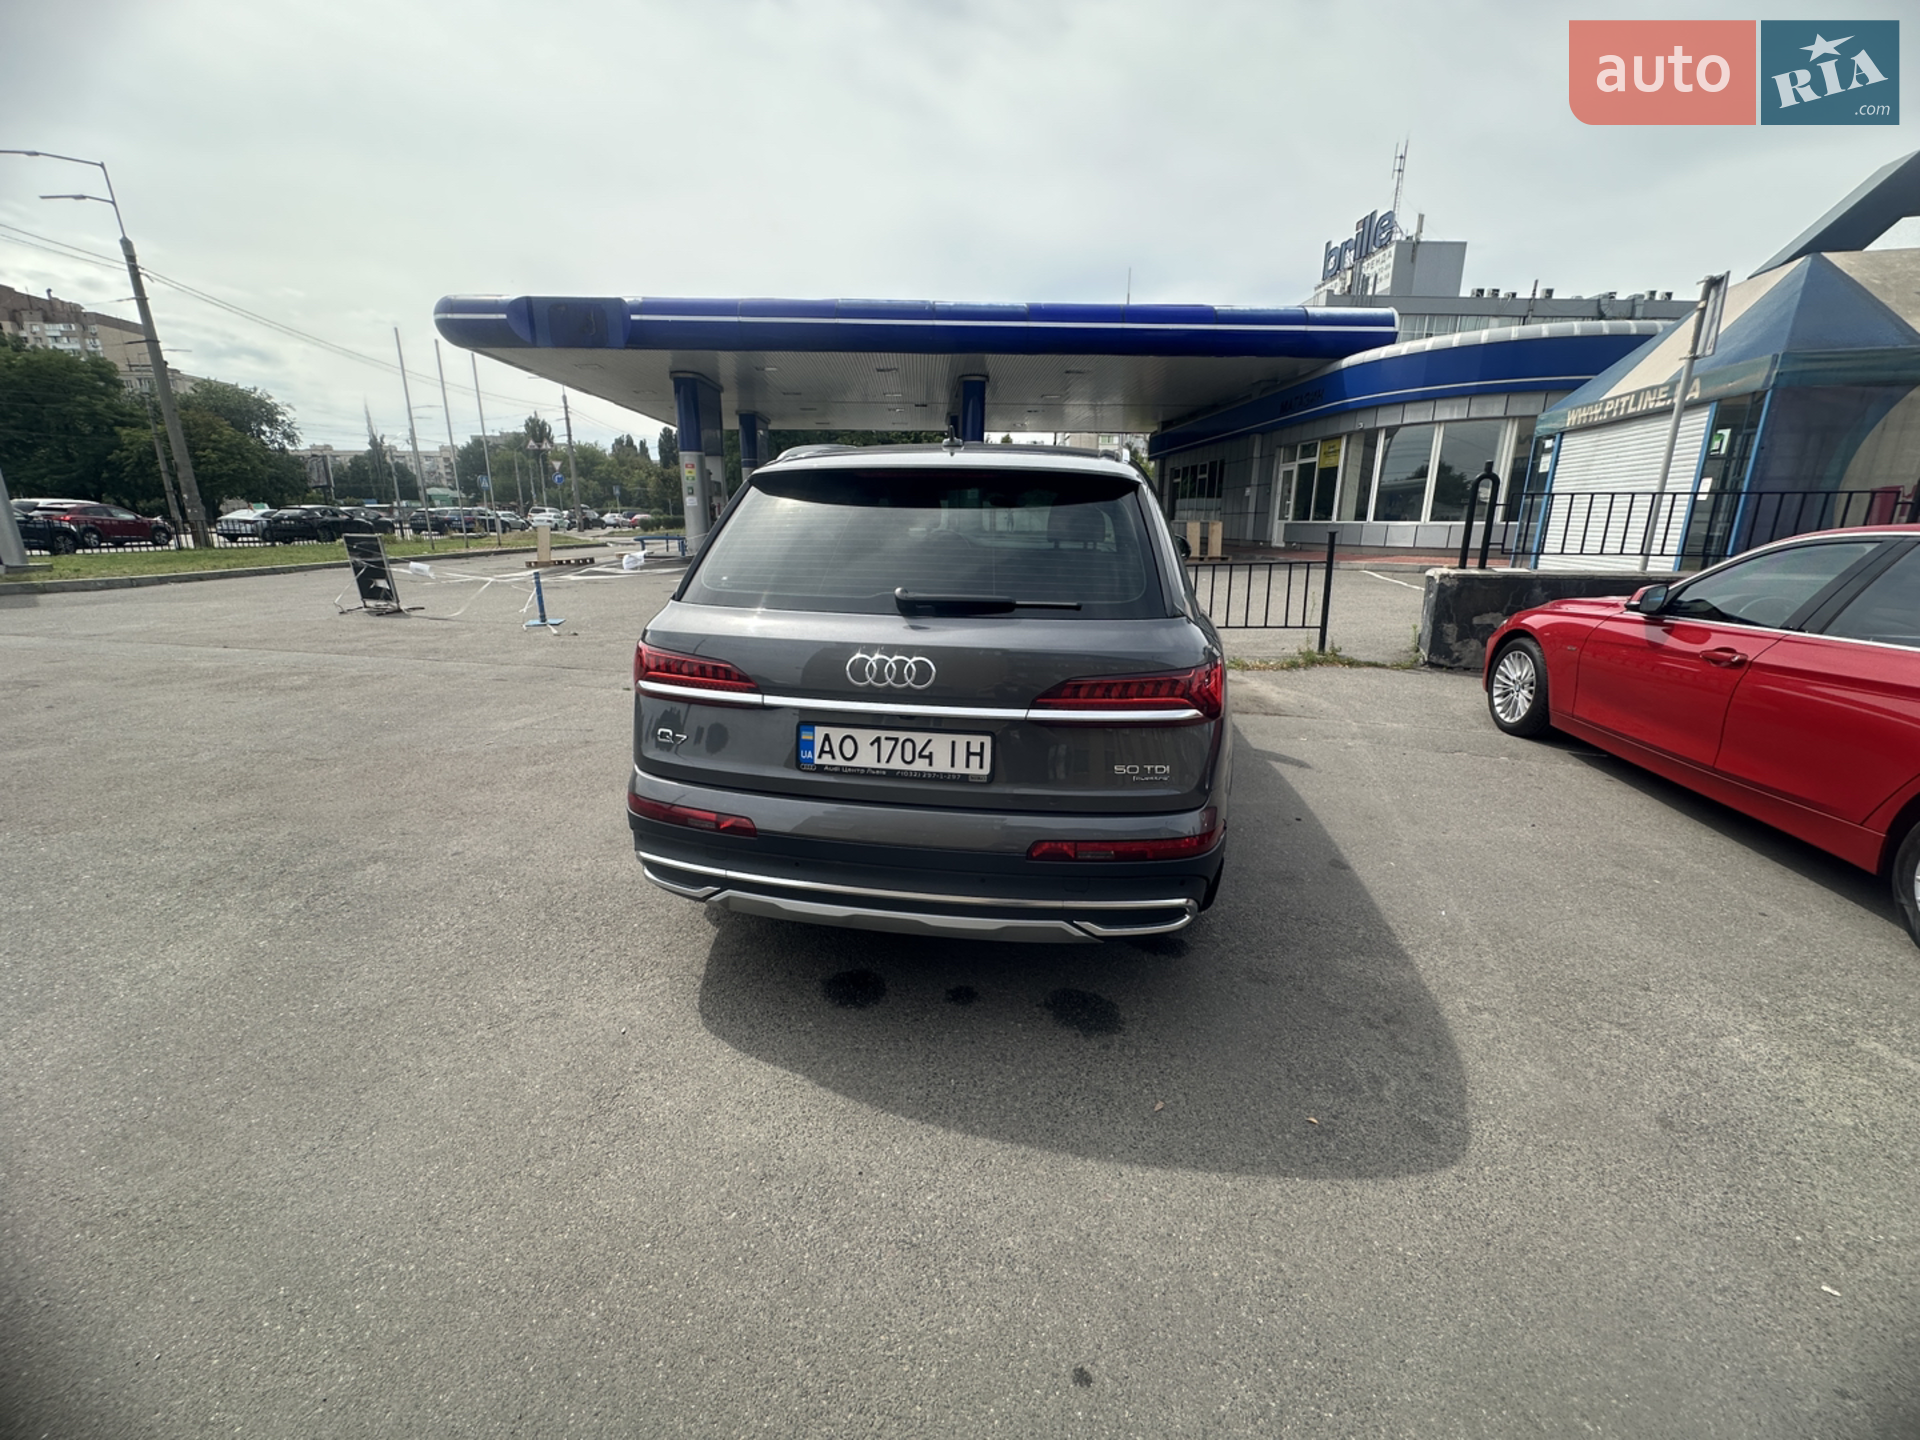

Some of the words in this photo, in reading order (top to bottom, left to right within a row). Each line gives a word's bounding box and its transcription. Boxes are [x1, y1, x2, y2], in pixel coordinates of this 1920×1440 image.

[1322, 209, 1395, 281] brille
[657, 728, 688, 745] Q7
[801, 750, 813, 760] UA
[817, 733, 858, 762] AO
[869, 736, 933, 767] 1704
[950, 739, 985, 769] IH
[1114, 764, 1140, 775] 50
[1143, 764, 1170, 775] TDI
